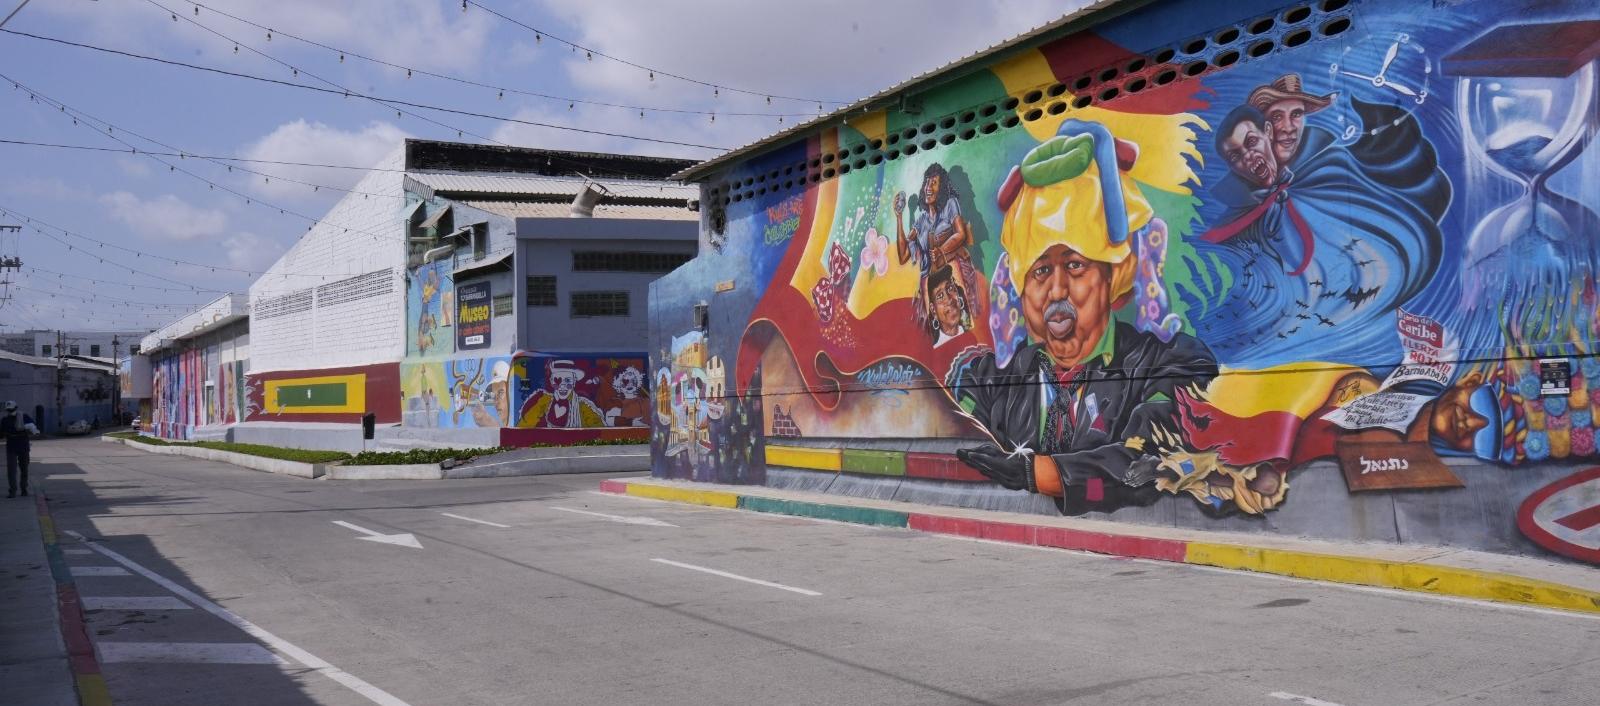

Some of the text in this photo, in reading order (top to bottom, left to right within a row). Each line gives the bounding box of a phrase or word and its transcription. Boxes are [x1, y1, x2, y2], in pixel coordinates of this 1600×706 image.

[1415, 90, 1428, 105] 3
[1341, 125, 1356, 140] 9
[1398, 319, 1437, 341] Caribe
[1392, 365, 1448, 384] Barrio Abajo
[1360, 455, 1409, 475] נתנאל
